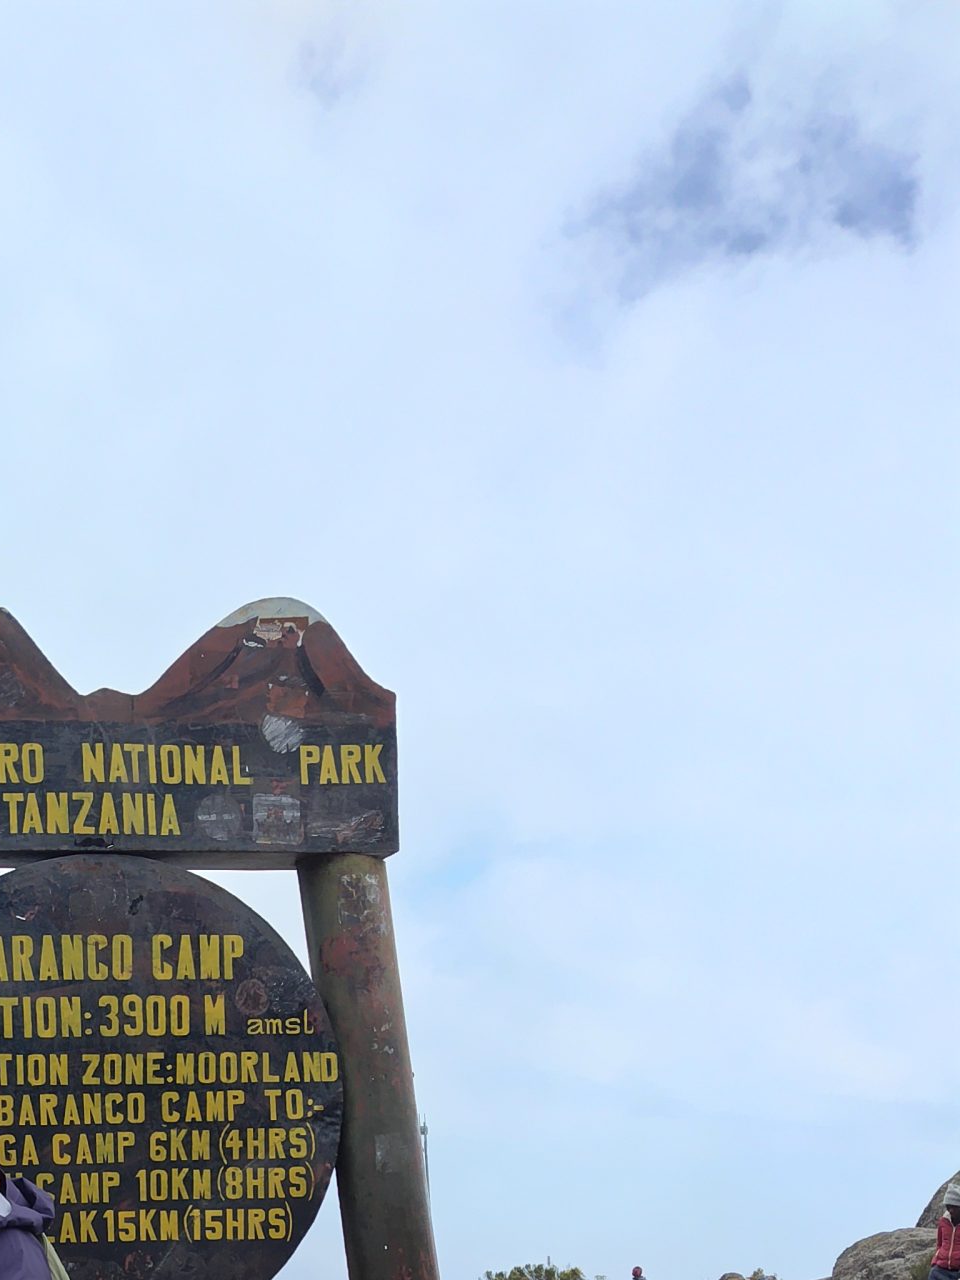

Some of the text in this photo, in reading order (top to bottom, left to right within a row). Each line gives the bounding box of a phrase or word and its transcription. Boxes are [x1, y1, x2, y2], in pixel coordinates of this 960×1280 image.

[82, 743, 252, 786] NATIONAL
[300, 744, 386, 785] PARK
[3, 792, 180, 836] TANZANIA
[152, 934, 245, 980] CAMP
[204, 994, 226, 1036] M
[247, 1009, 315, 1035] amsl
[161, 1090, 246, 1123] CAMP
[51, 1132, 136, 1165] CAMP
[149, 1129, 211, 1162] 6KM
[218, 1123, 316, 1165] (4HRS)
